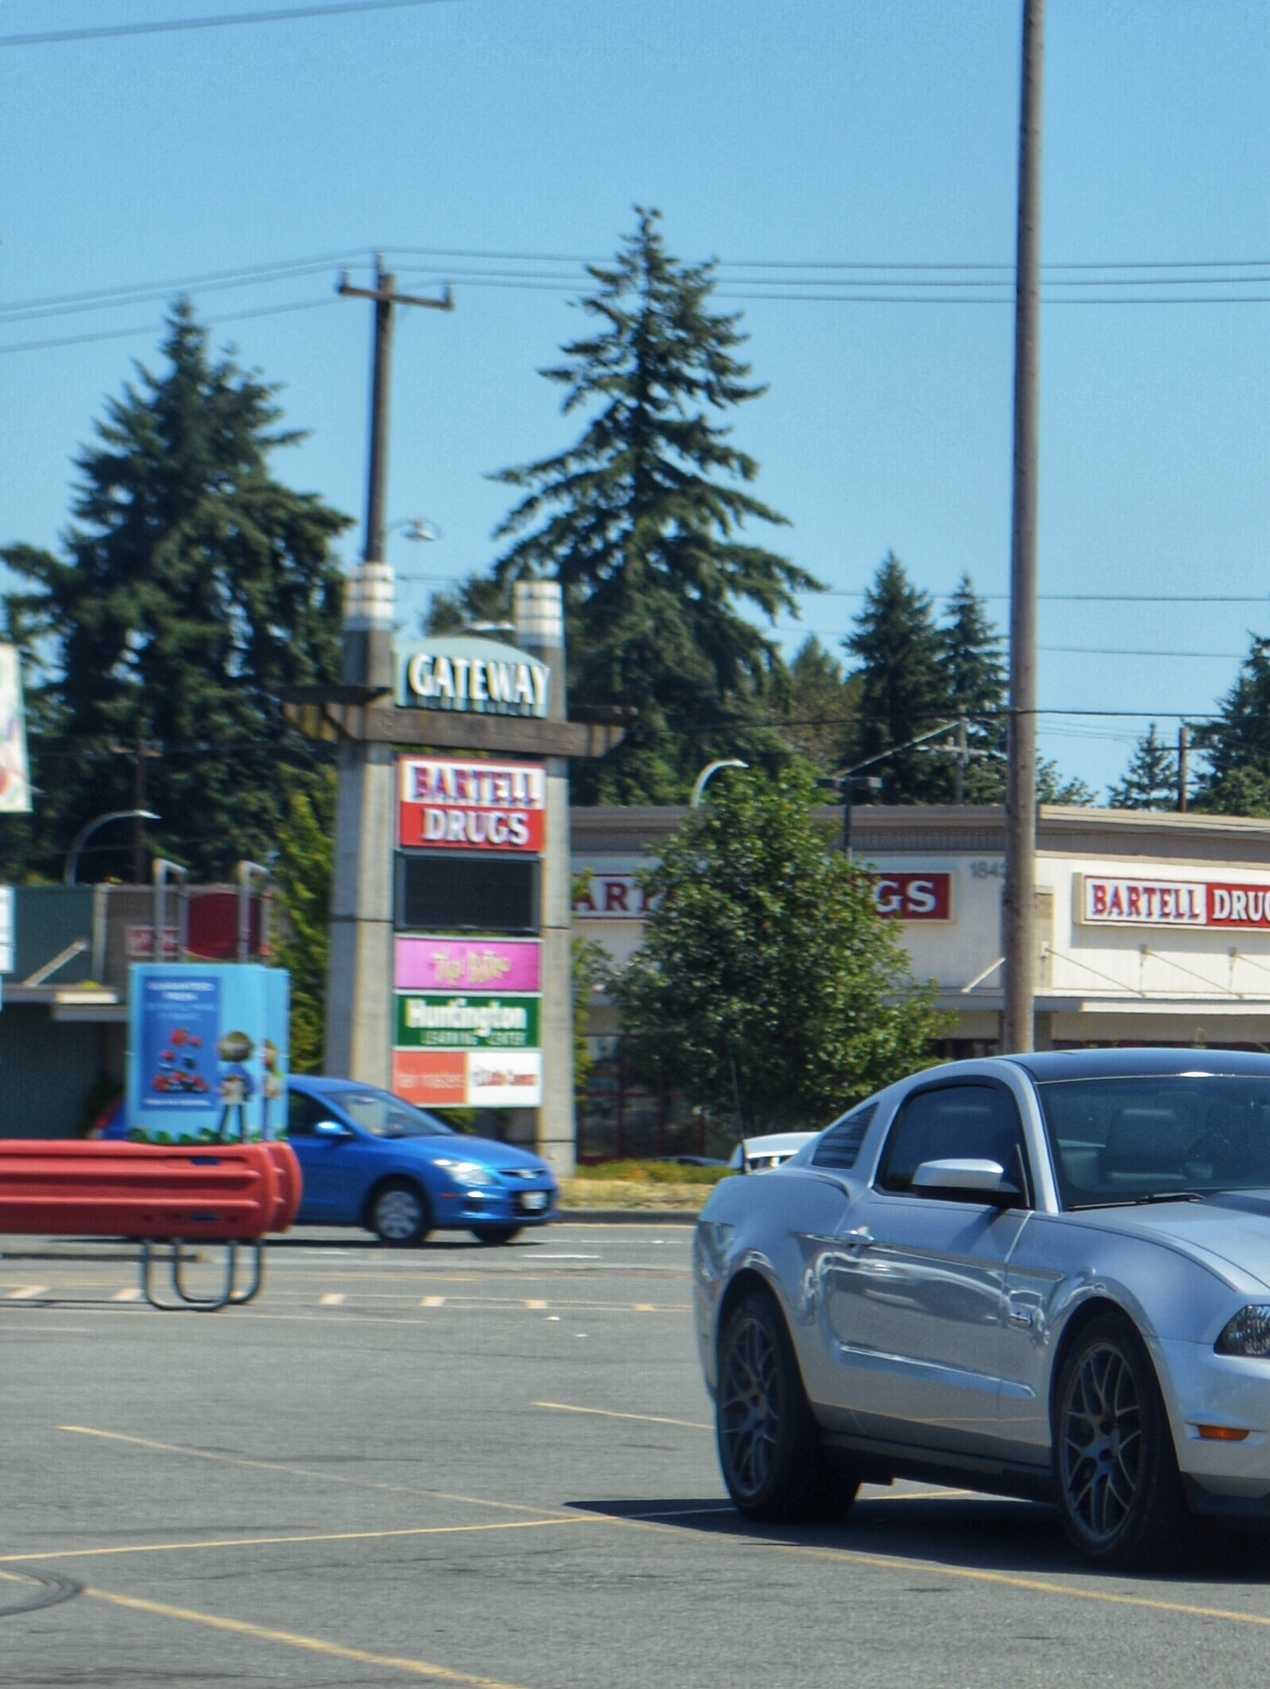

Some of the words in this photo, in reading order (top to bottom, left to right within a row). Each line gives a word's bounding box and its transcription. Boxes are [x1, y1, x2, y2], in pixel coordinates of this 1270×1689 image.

[408, 652, 550, 706] GATEWAY
[413, 766, 541, 804] BARTELL
[422, 808, 530, 845] DRUGS
[1092, 884, 1201, 918] BARTELL
[405, 998, 527, 1037] Huntington
